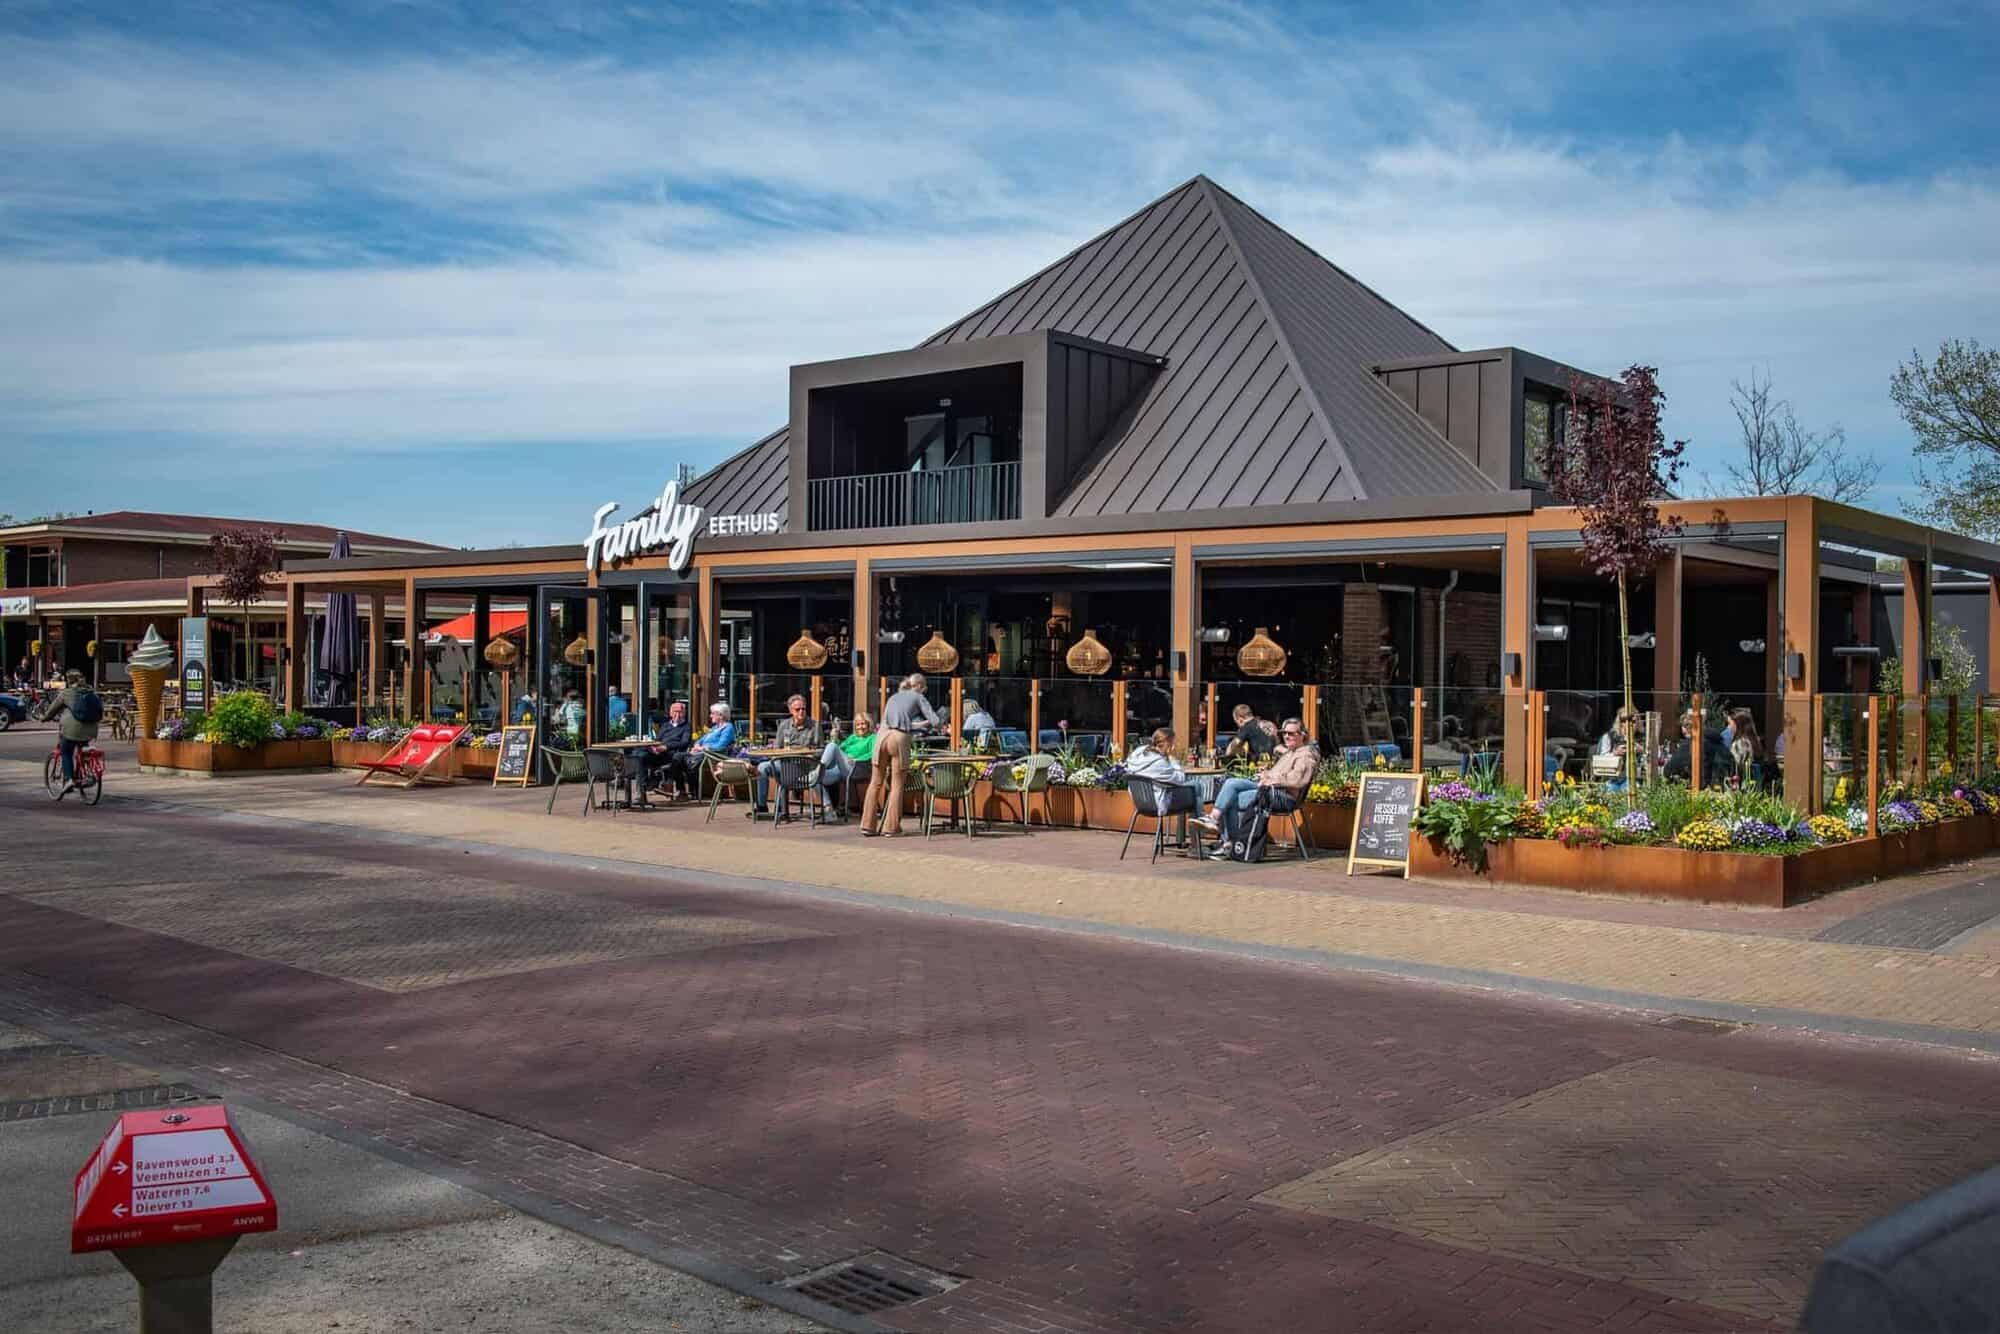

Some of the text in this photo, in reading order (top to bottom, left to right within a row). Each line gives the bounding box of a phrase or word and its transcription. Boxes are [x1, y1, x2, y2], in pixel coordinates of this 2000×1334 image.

[584, 480, 779, 570] Family EETHUIS
[136, 1154, 214, 1170] Ravenswoud
[136, 1166, 227, 1182] Veenhuizen 12
[136, 1187, 190, 1200] Wateren
[135, 1199, 193, 1213] Diever 13
